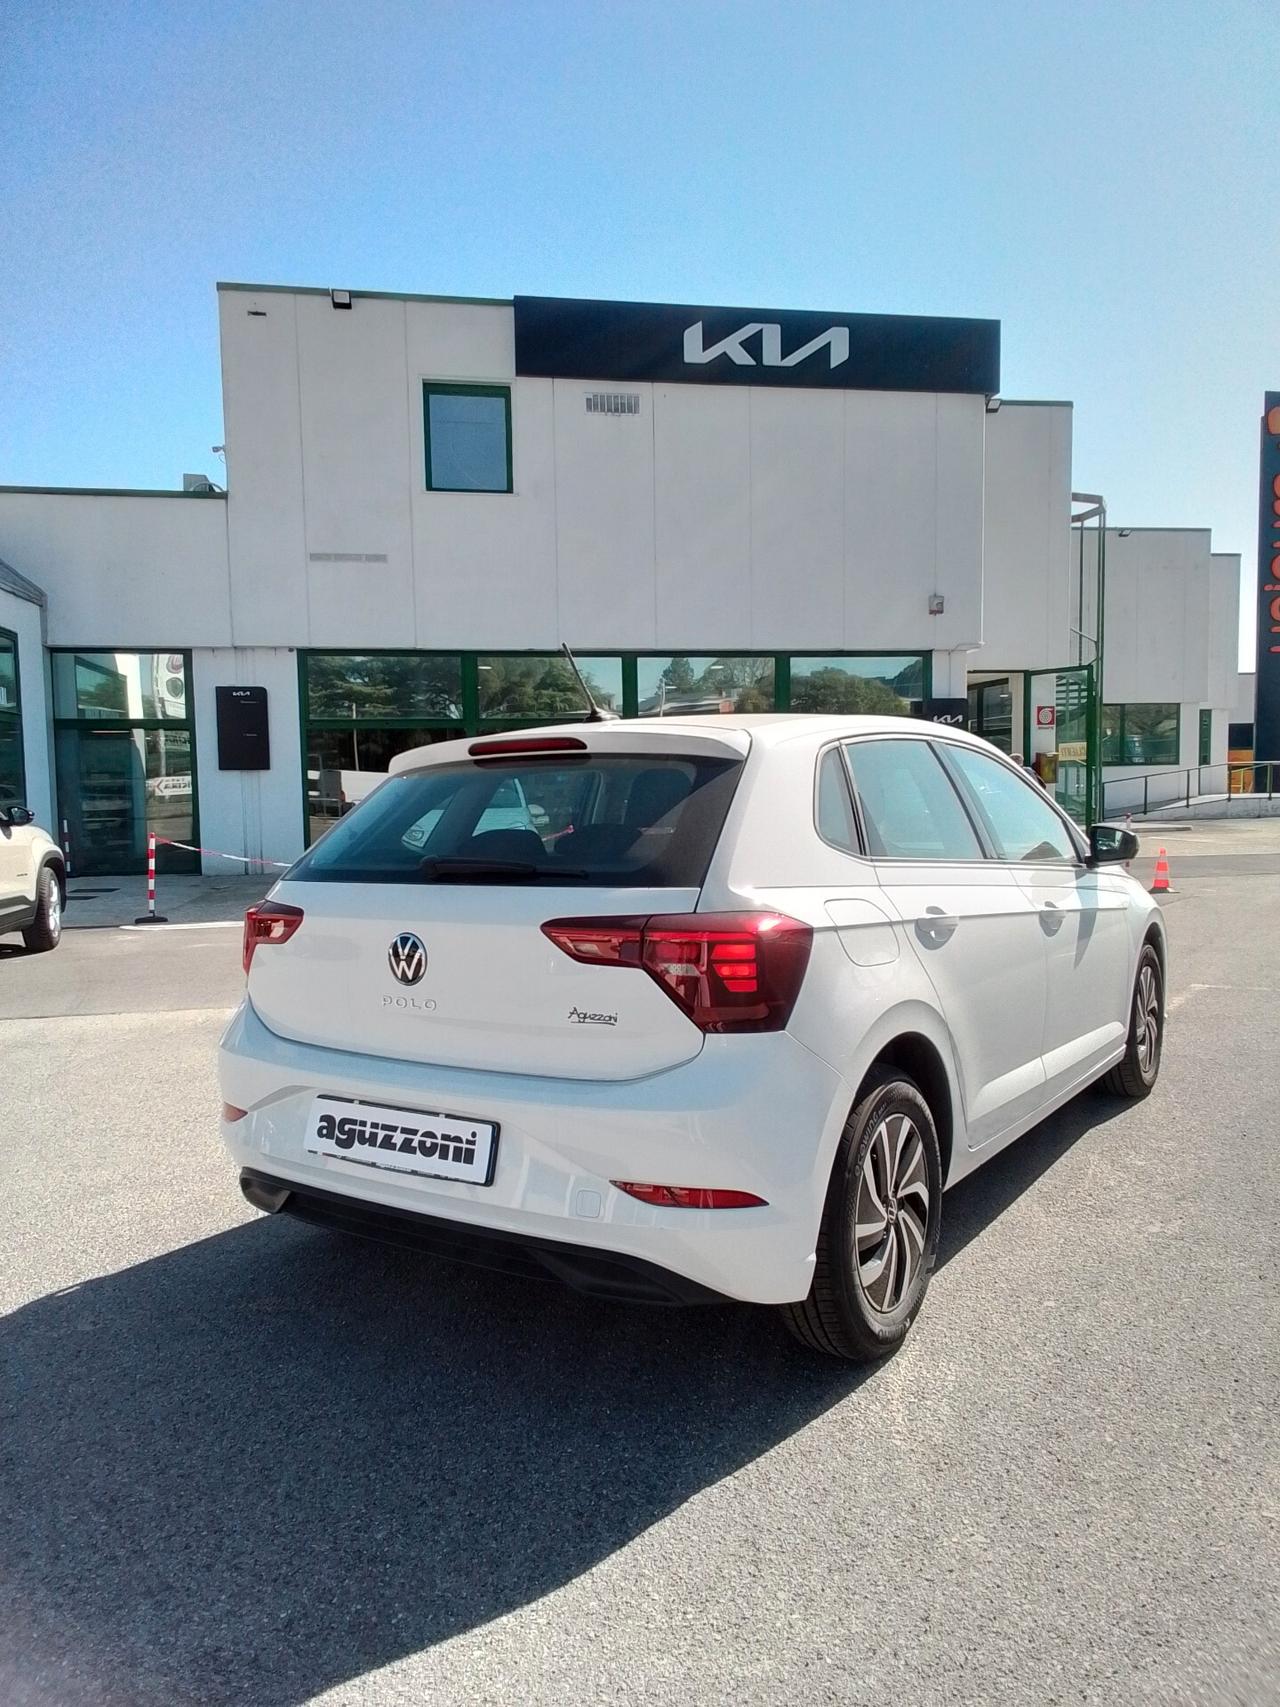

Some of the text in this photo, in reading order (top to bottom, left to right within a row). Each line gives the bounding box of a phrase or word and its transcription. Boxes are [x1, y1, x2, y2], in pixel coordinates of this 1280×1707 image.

[683, 320, 850, 369] KIA
[933, 714, 963, 724] KIA
[383, 995, 437, 1011] POLO
[568, 1006, 618, 1025] Aguzzoni
[316, 1114, 478, 1165] aguzzoni
